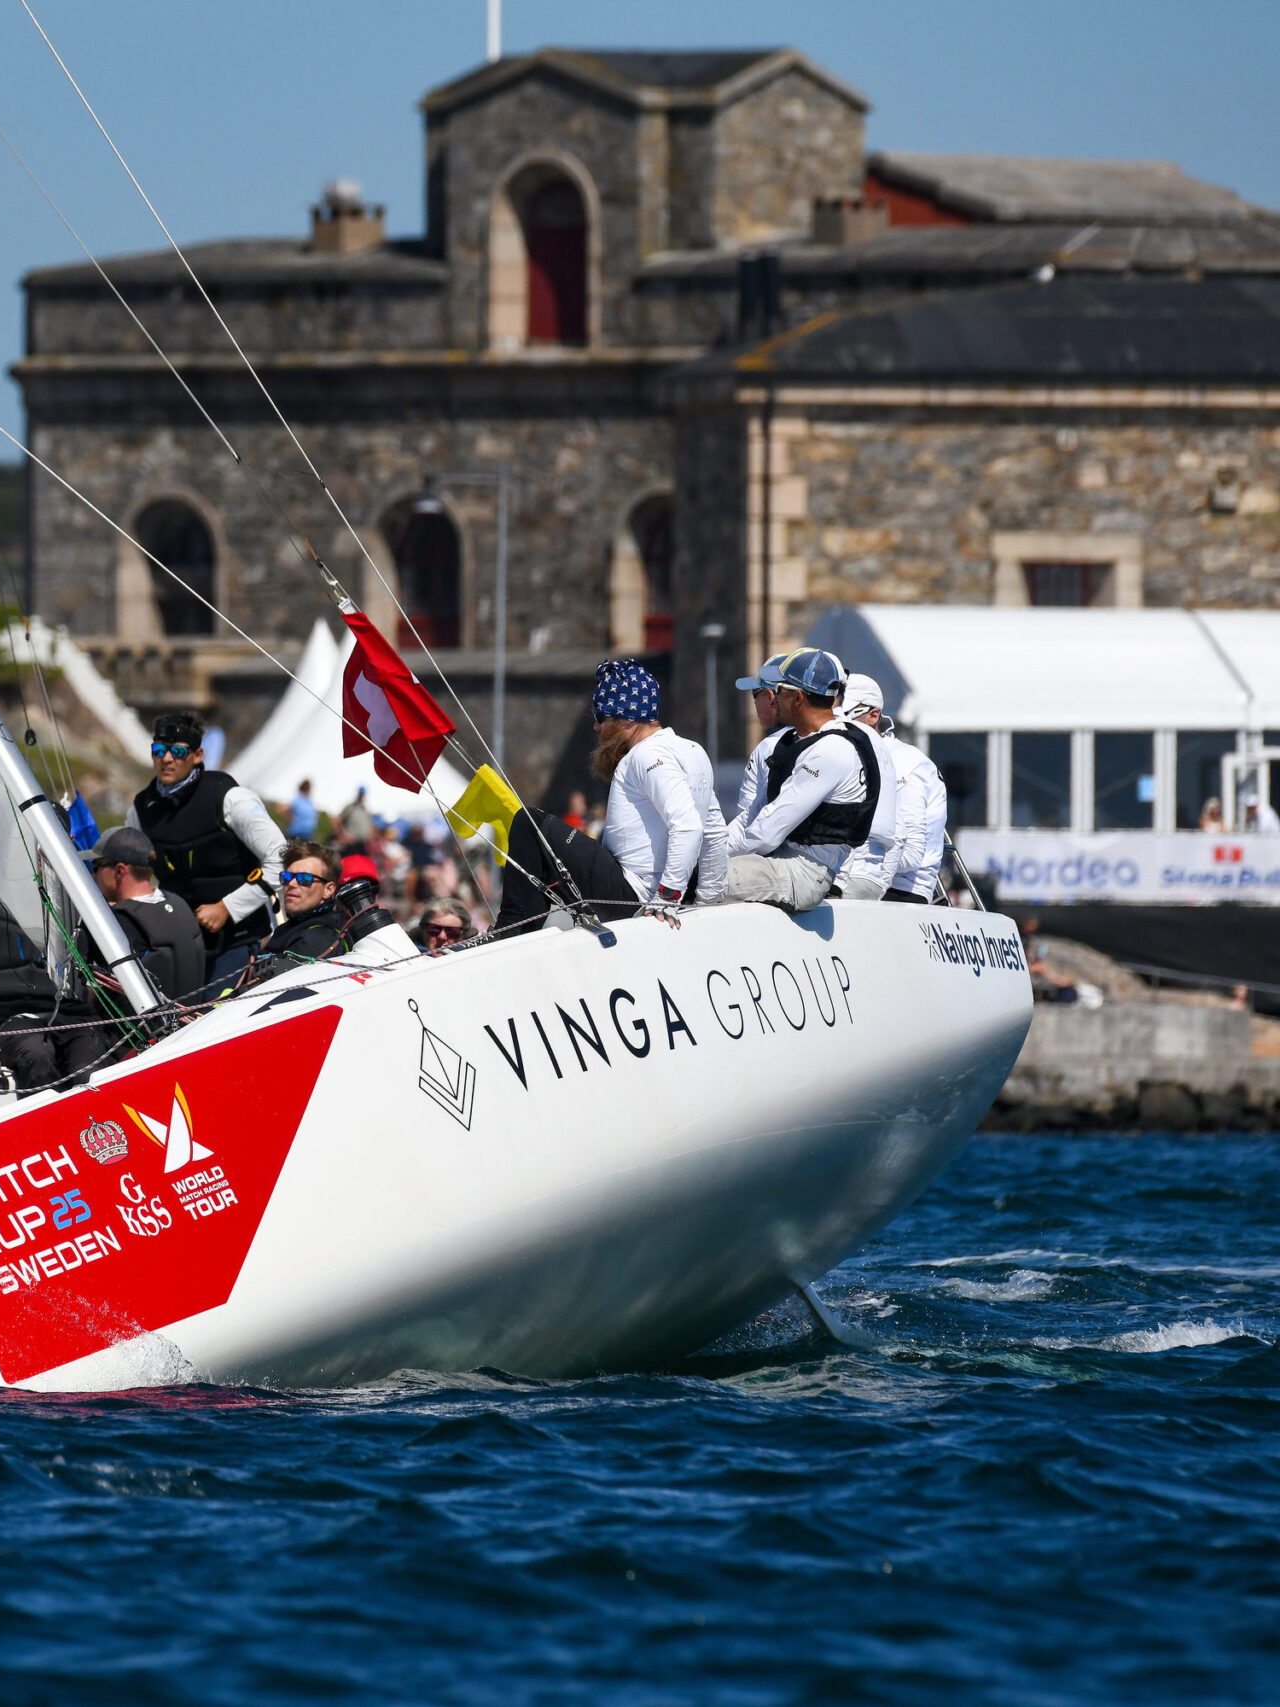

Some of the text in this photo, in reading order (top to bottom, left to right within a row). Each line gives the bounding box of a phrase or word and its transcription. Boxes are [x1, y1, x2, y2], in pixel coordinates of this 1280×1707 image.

[930, 923, 1025, 977] Navigo Invest
[483, 955, 854, 1092] VINGA GROUP
[120, 1172, 146, 1204] G
[171, 1165, 224, 1194] WORLD
[179, 1179, 229, 1204] MATCH RACING
[49, 1188, 91, 1230] 25
[115, 1195, 172, 1237] KSS
[183, 1188, 238, 1220] TOUR
